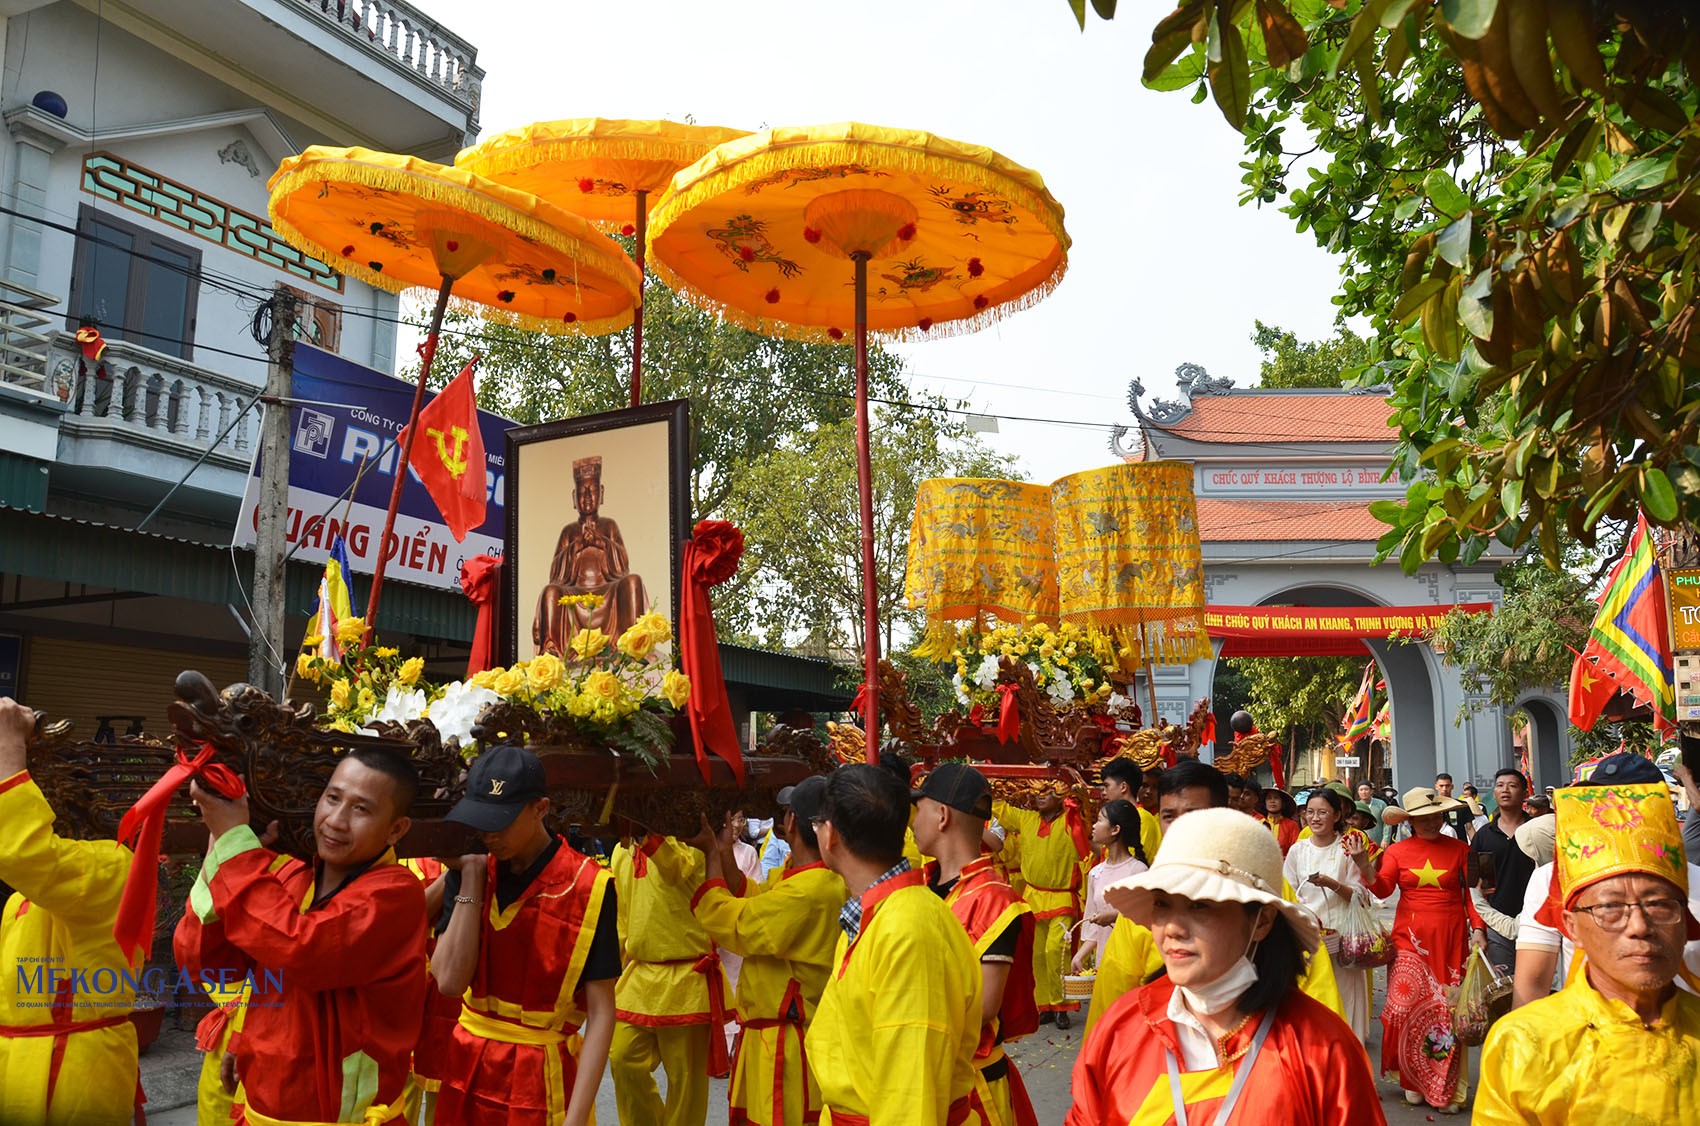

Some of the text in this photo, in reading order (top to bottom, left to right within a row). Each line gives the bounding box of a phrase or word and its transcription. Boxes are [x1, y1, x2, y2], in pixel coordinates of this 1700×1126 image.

[382, 417, 395, 431] TY
[1212, 468, 1239, 485] CHÚC
[1240, 468, 1260, 485] QUÝ
[1263, 468, 1297, 485] KHÁCH
[1301, 470, 1338, 488] THƯỢNG
[1341, 467, 1354, 487] LỘ
[1358, 467, 1380, 484] BÌNH
[1225, 613, 1250, 628] CHÚC
[1252, 613, 1270, 630] QUÝ
[1271, 614, 1303, 630] KHÁCH
[1304, 617, 1318, 630] AN
[1319, 617, 1354, 631] KHANG,
[1354, 617, 1382, 632] THỊNH
[1415, 613, 1428, 629] VÀ
[1429, 612, 1448, 629] THÀ
